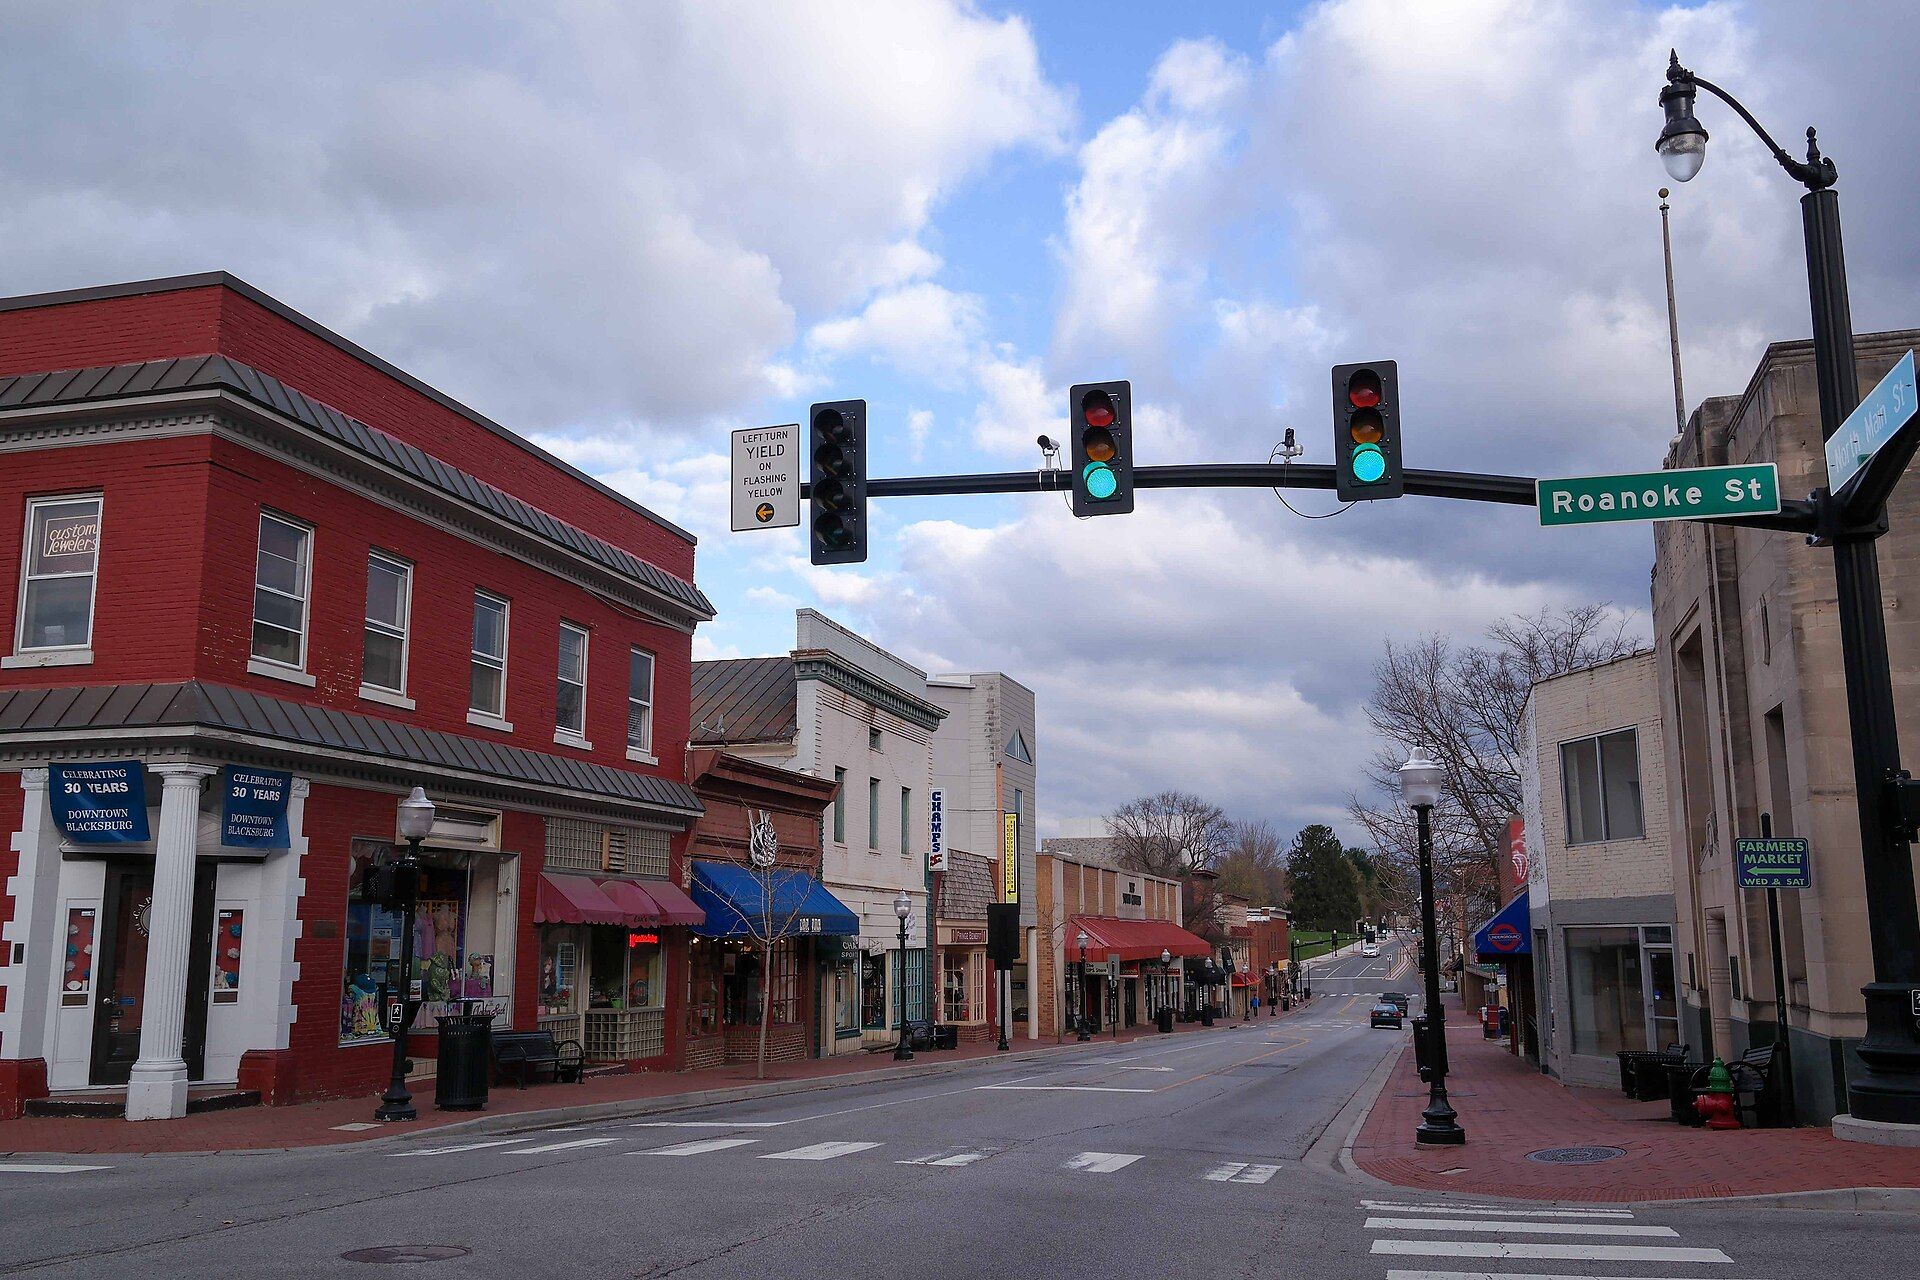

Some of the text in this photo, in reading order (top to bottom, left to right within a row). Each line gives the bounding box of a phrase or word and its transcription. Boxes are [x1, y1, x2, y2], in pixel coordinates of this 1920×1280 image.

[1834, 379, 1905, 472] North Main St
[743, 431, 788, 443] LEFT TURN
[746, 444, 785, 459] YIELD
[759, 462, 771, 471] ON
[744, 473, 787, 486] FLASHING
[748, 487, 782, 498] YELLOW
[1552, 477, 1762, 514] Roanoke St
[62, 769, 127, 779] CELEBRATING
[233, 773, 282, 787] CELEBRATING
[64, 782, 129, 794] 30 YEARS
[232, 786, 281, 801] 30 YEARS
[68, 808, 129, 820] DOWNTOWN
[231, 813, 274, 825] DOWNTOWN
[66, 820, 133, 831] BLACKSBURG
[932, 792, 942, 853] CHAMPS
[228, 825, 274, 837] BLACKSBURG
[1739, 841, 1804, 852] FARMERS
[1743, 854, 1802, 864] MARKET
[1771, 878, 1781, 886] &
[1786, 878, 1805, 886] SAT
